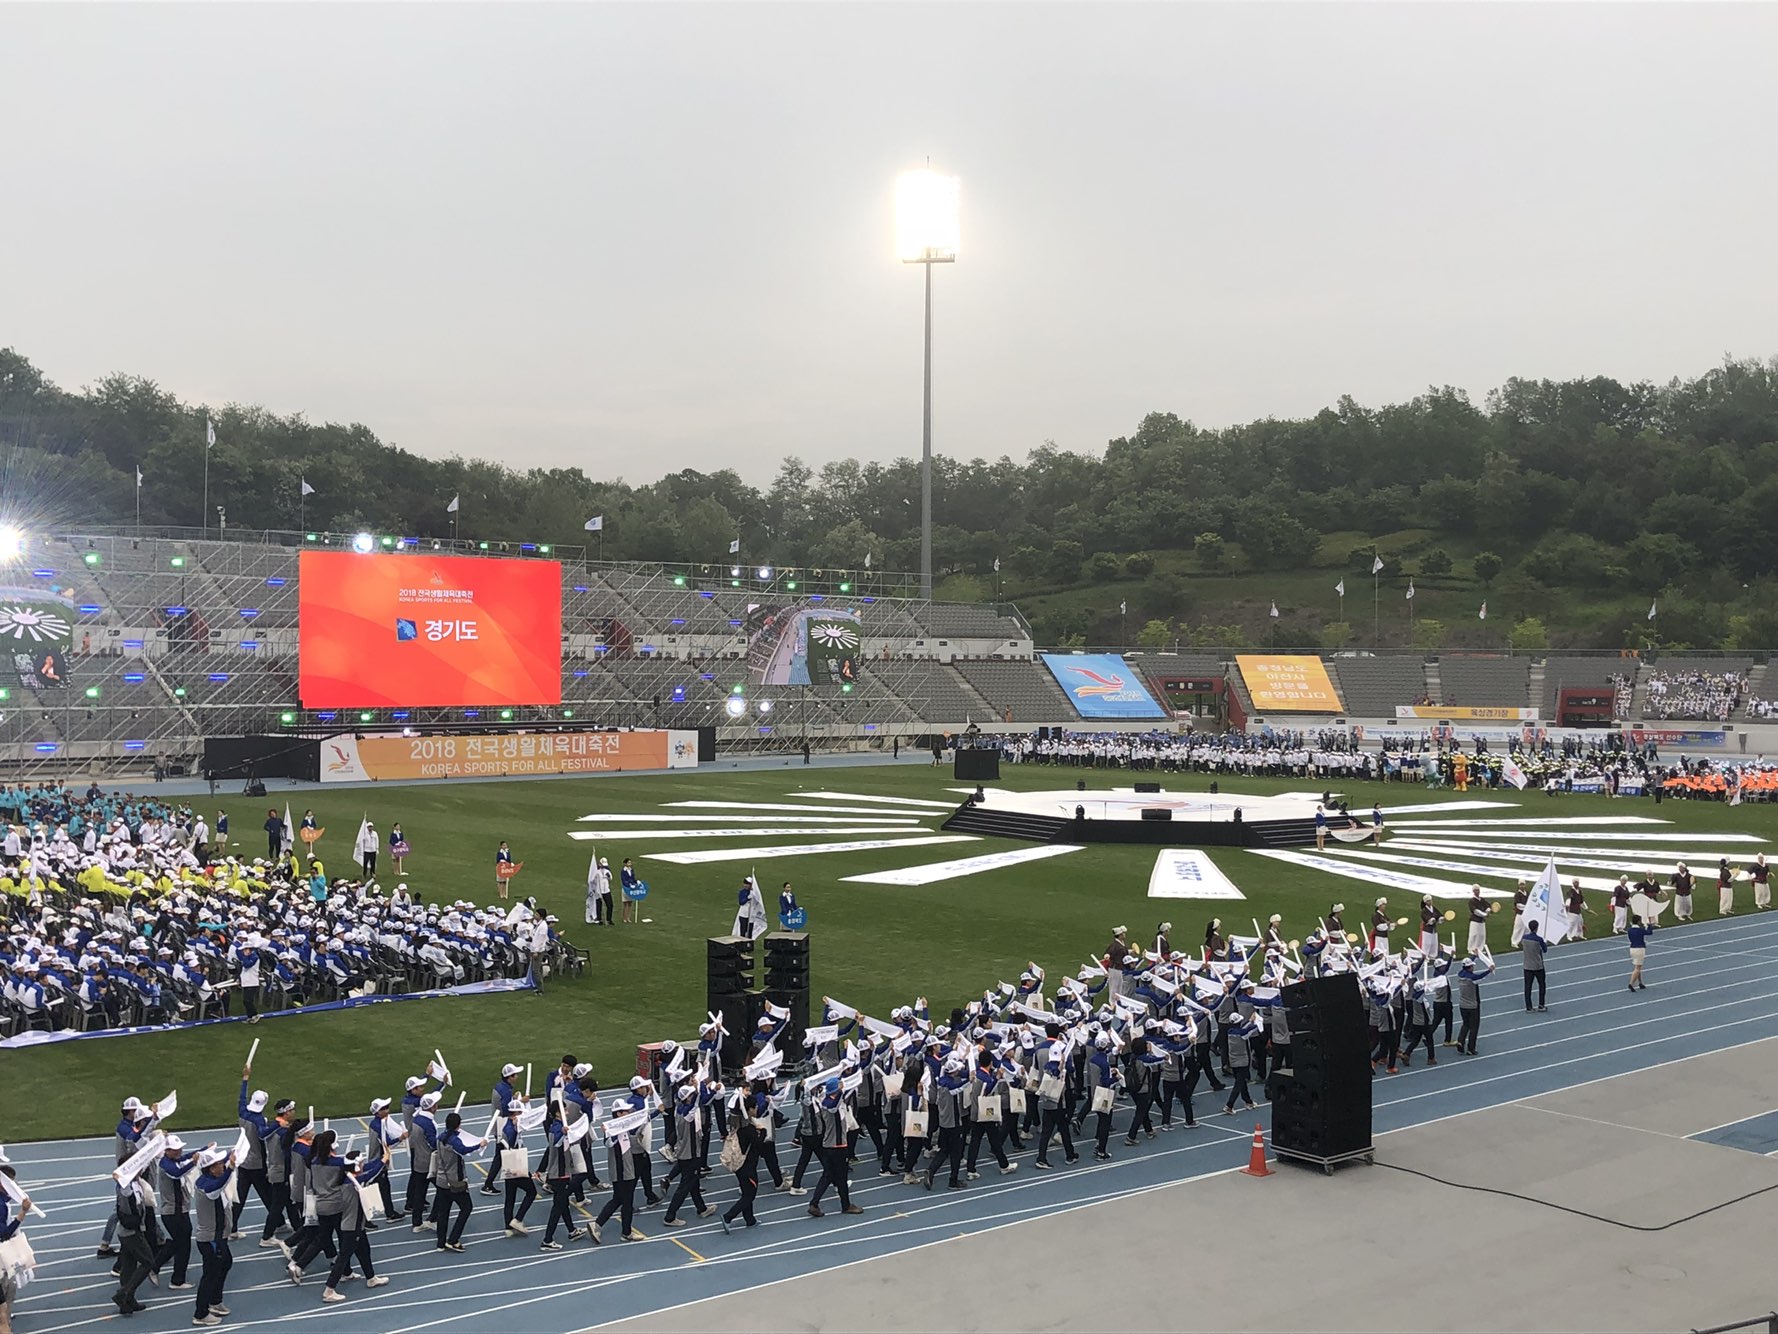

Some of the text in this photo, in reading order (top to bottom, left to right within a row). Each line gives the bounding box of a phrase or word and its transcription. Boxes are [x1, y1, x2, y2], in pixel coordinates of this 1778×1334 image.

[399, 588, 473, 599] 2018 전국생활체육대축전
[424, 619, 479, 642] 경기도
[1259, 691, 1327, 699] 환영합니다
[1471, 708, 1509, 718] 육상경기장
[410, 733, 620, 760] 2018 전국생활체육대축전
[421, 757, 610, 776] KOREA SPORTS FOR ALL FESTIVAL
